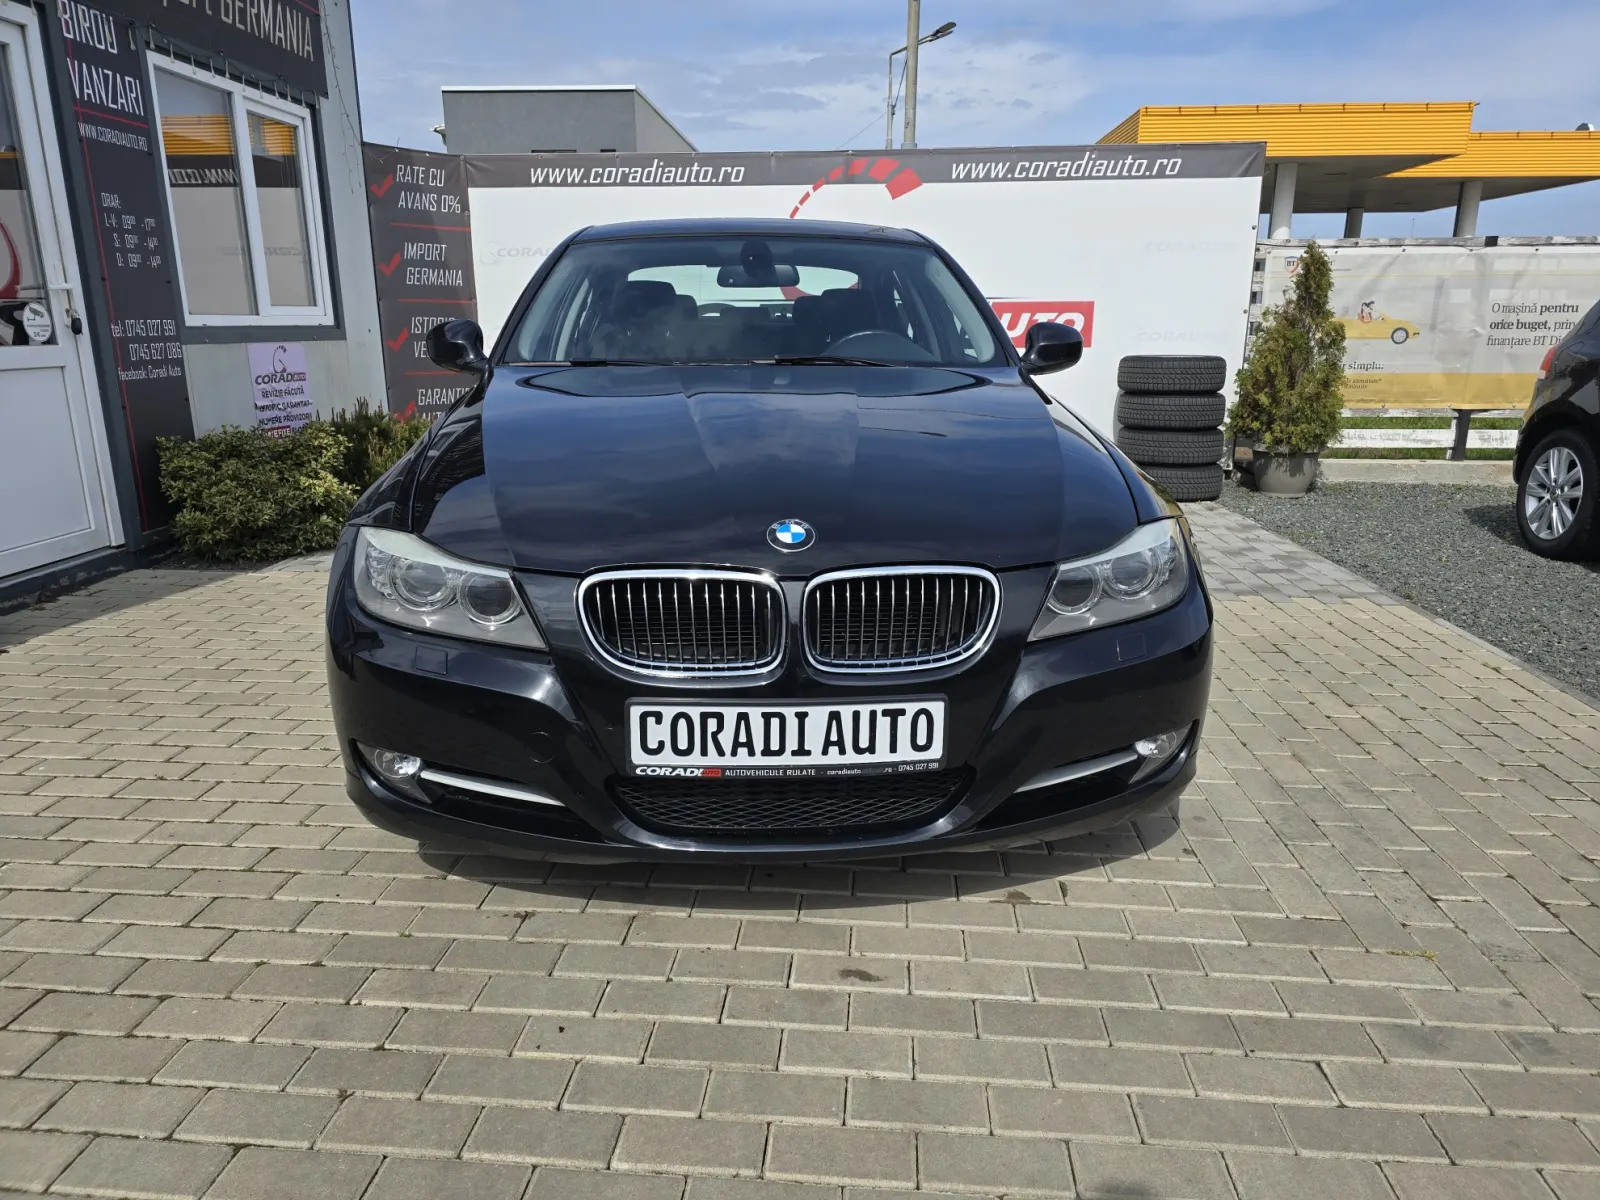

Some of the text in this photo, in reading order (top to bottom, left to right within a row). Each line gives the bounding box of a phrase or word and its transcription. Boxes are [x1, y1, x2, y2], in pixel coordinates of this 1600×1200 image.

[59, 0, 118, 54] BIROU
[66, 57, 144, 117] VANZARI
[530, 158, 745, 184] www.coradiauto.ro
[950, 152, 1182, 180] www.coradiauto.ro
[396, 164, 445, 187] RATE CU
[101, 192, 121, 209] ORAR:
[397, 191, 461, 214] AVANS 0%
[404, 241, 447, 262] IMPORT
[406, 267, 463, 288] GERMANIA
[1492, 302, 1501, 314] O
[1540, 303, 1579, 315] pentru
[111, 320, 125, 337] tel:
[125, 319, 146, 337] 0745
[147, 319, 161, 336] 027
[1489, 319, 1514, 330] orice
[1516, 319, 1551, 332] buget,
[1486, 335, 1531, 348] finanțare
[1533, 335, 1548, 346] BT
[129, 342, 182, 360] 0745 627 086
[1348, 361, 1384, 371] simplu:
[262, 388, 284, 399] REVIZIE
[771, 519, 811, 530] BMW
[638, 707, 935, 759] CORADI AUTO
[915, 763, 927, 771] 027
[928, 762, 939, 770] 991
